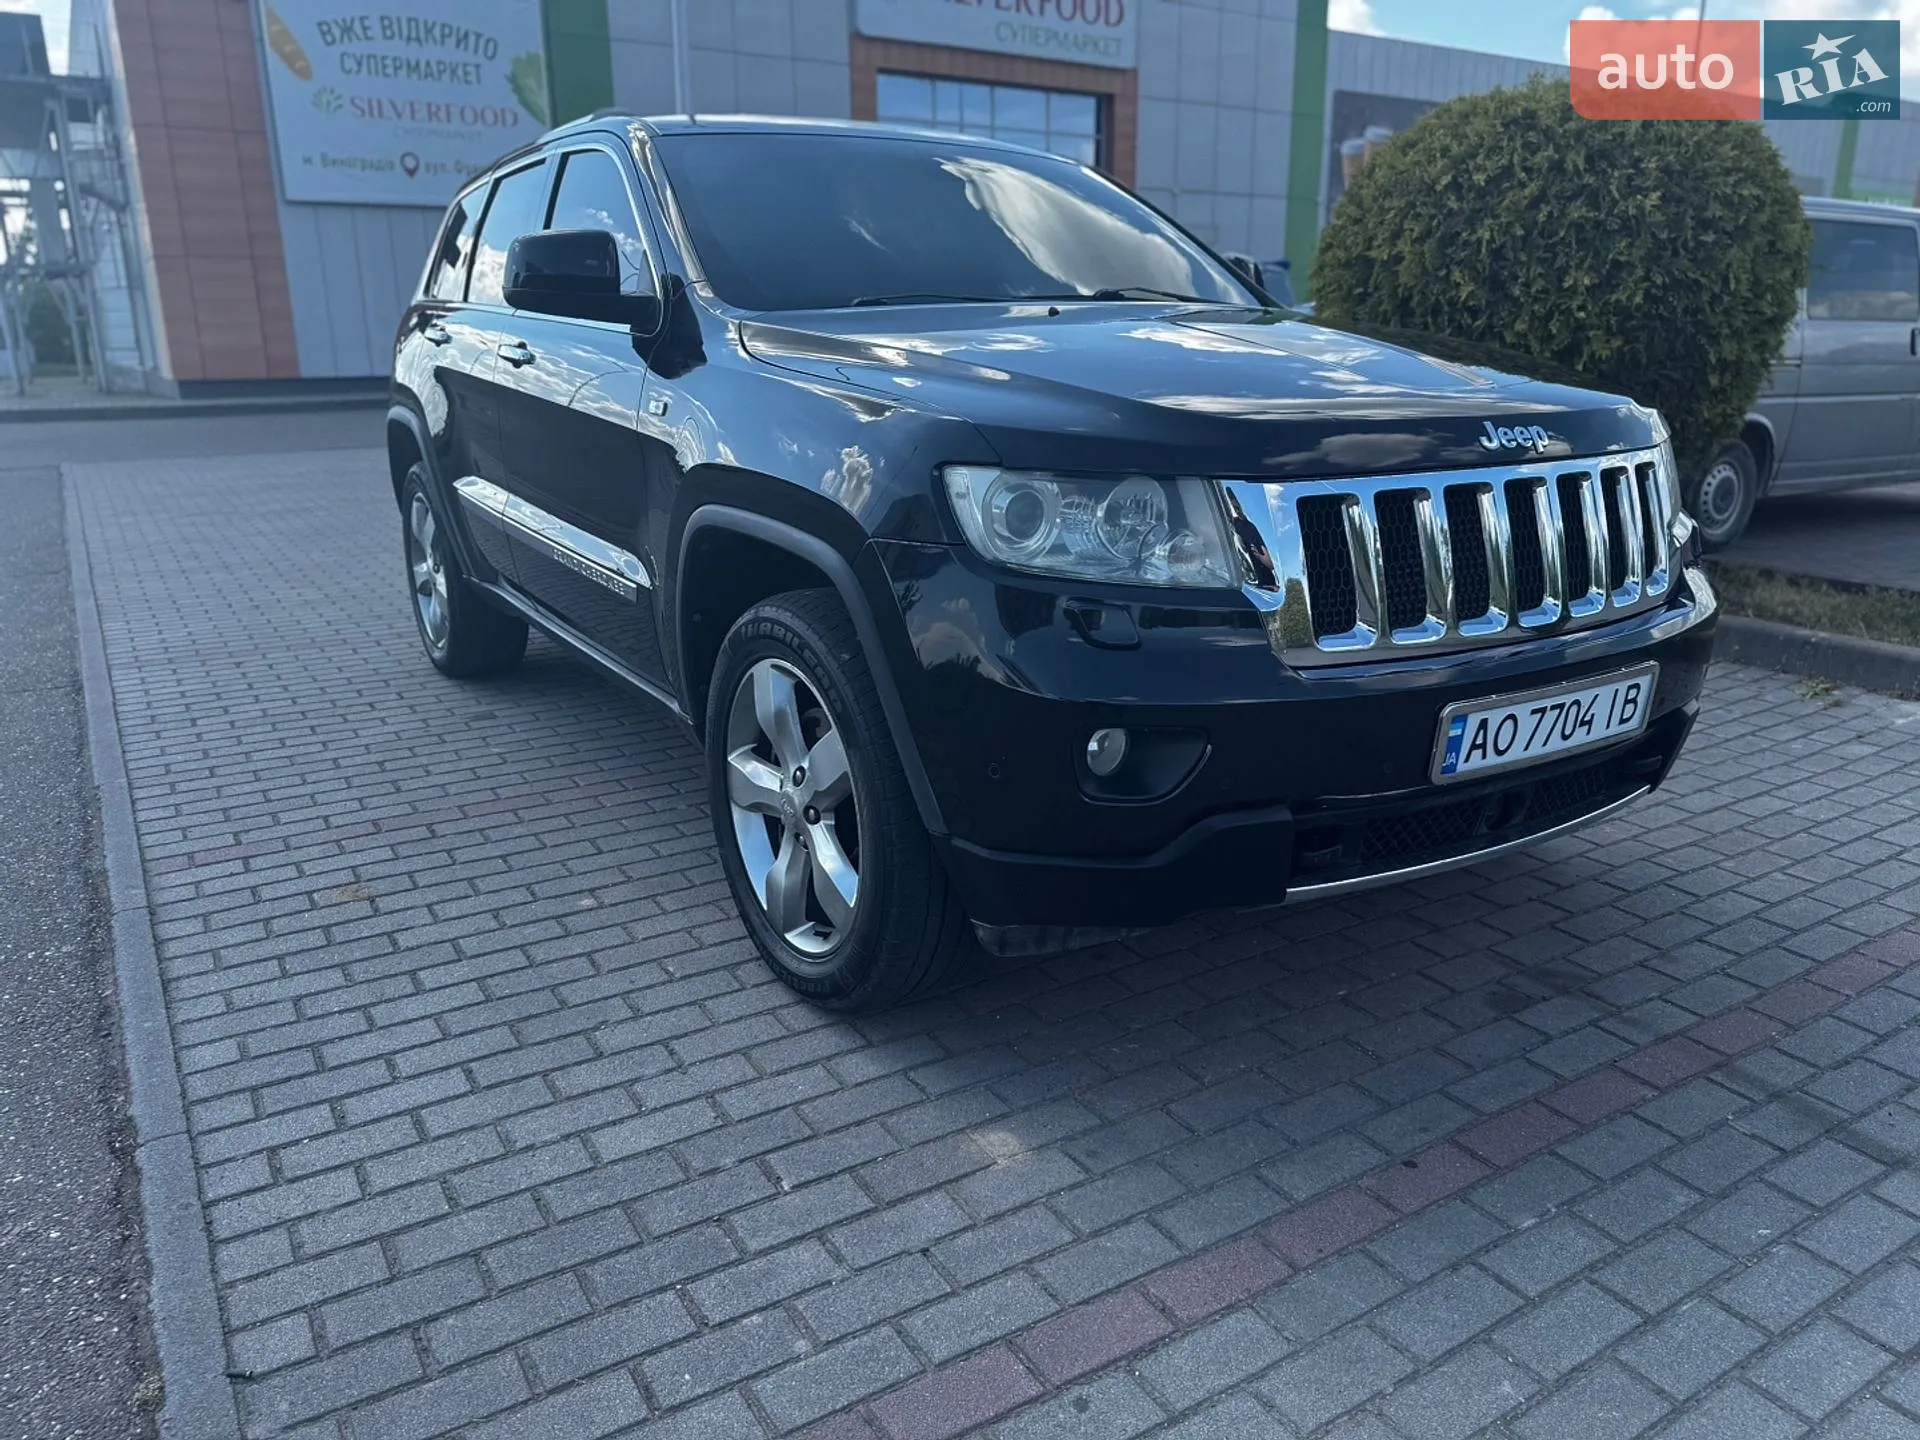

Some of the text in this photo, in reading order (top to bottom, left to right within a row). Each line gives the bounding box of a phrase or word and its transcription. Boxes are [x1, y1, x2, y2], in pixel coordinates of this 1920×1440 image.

[316, 15, 498, 61] ВЖЕ ВІДКРИТО
[995, 20, 1122, 57] СУПЕРМАРКЕТ
[339, 51, 482, 85] СУПЕРМАРКЕТ
[349, 95, 519, 129] SILVERFOOD
[1479, 421, 1549, 454] Jeep
[1463, 682, 1642, 763] AO 7704 IB
